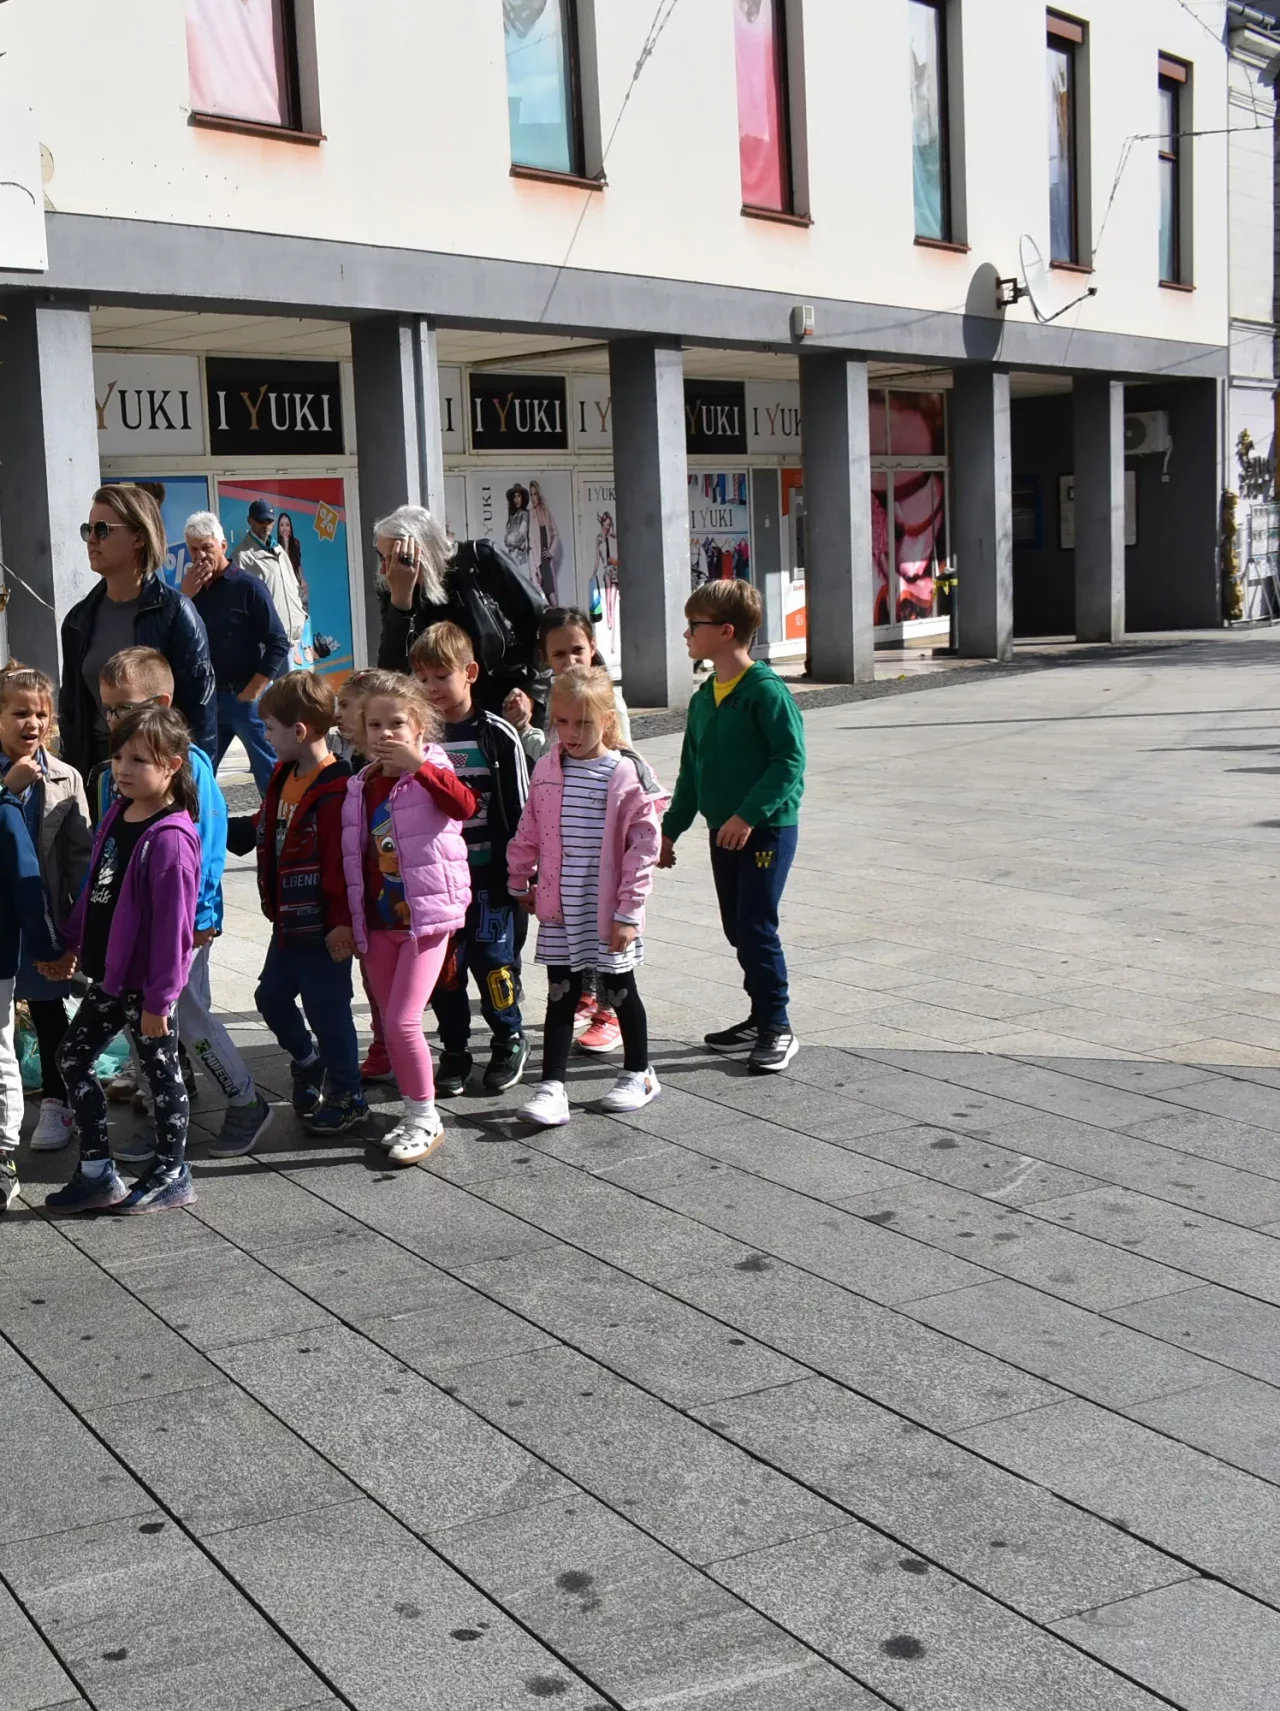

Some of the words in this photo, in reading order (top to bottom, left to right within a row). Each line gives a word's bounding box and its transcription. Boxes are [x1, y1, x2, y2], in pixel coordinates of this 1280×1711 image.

[95, 380, 192, 430] YUKI
[217, 391, 230, 430] I
[240, 384, 332, 431] YUKI
[474, 398, 485, 432] I
[492, 392, 563, 433] YUKI
[579, 401, 587, 432] I
[685, 399, 740, 436] YUKI
[753, 407, 760, 435] I
[595, 486, 616, 501] YUK
[700, 507, 734, 528] YUKI
